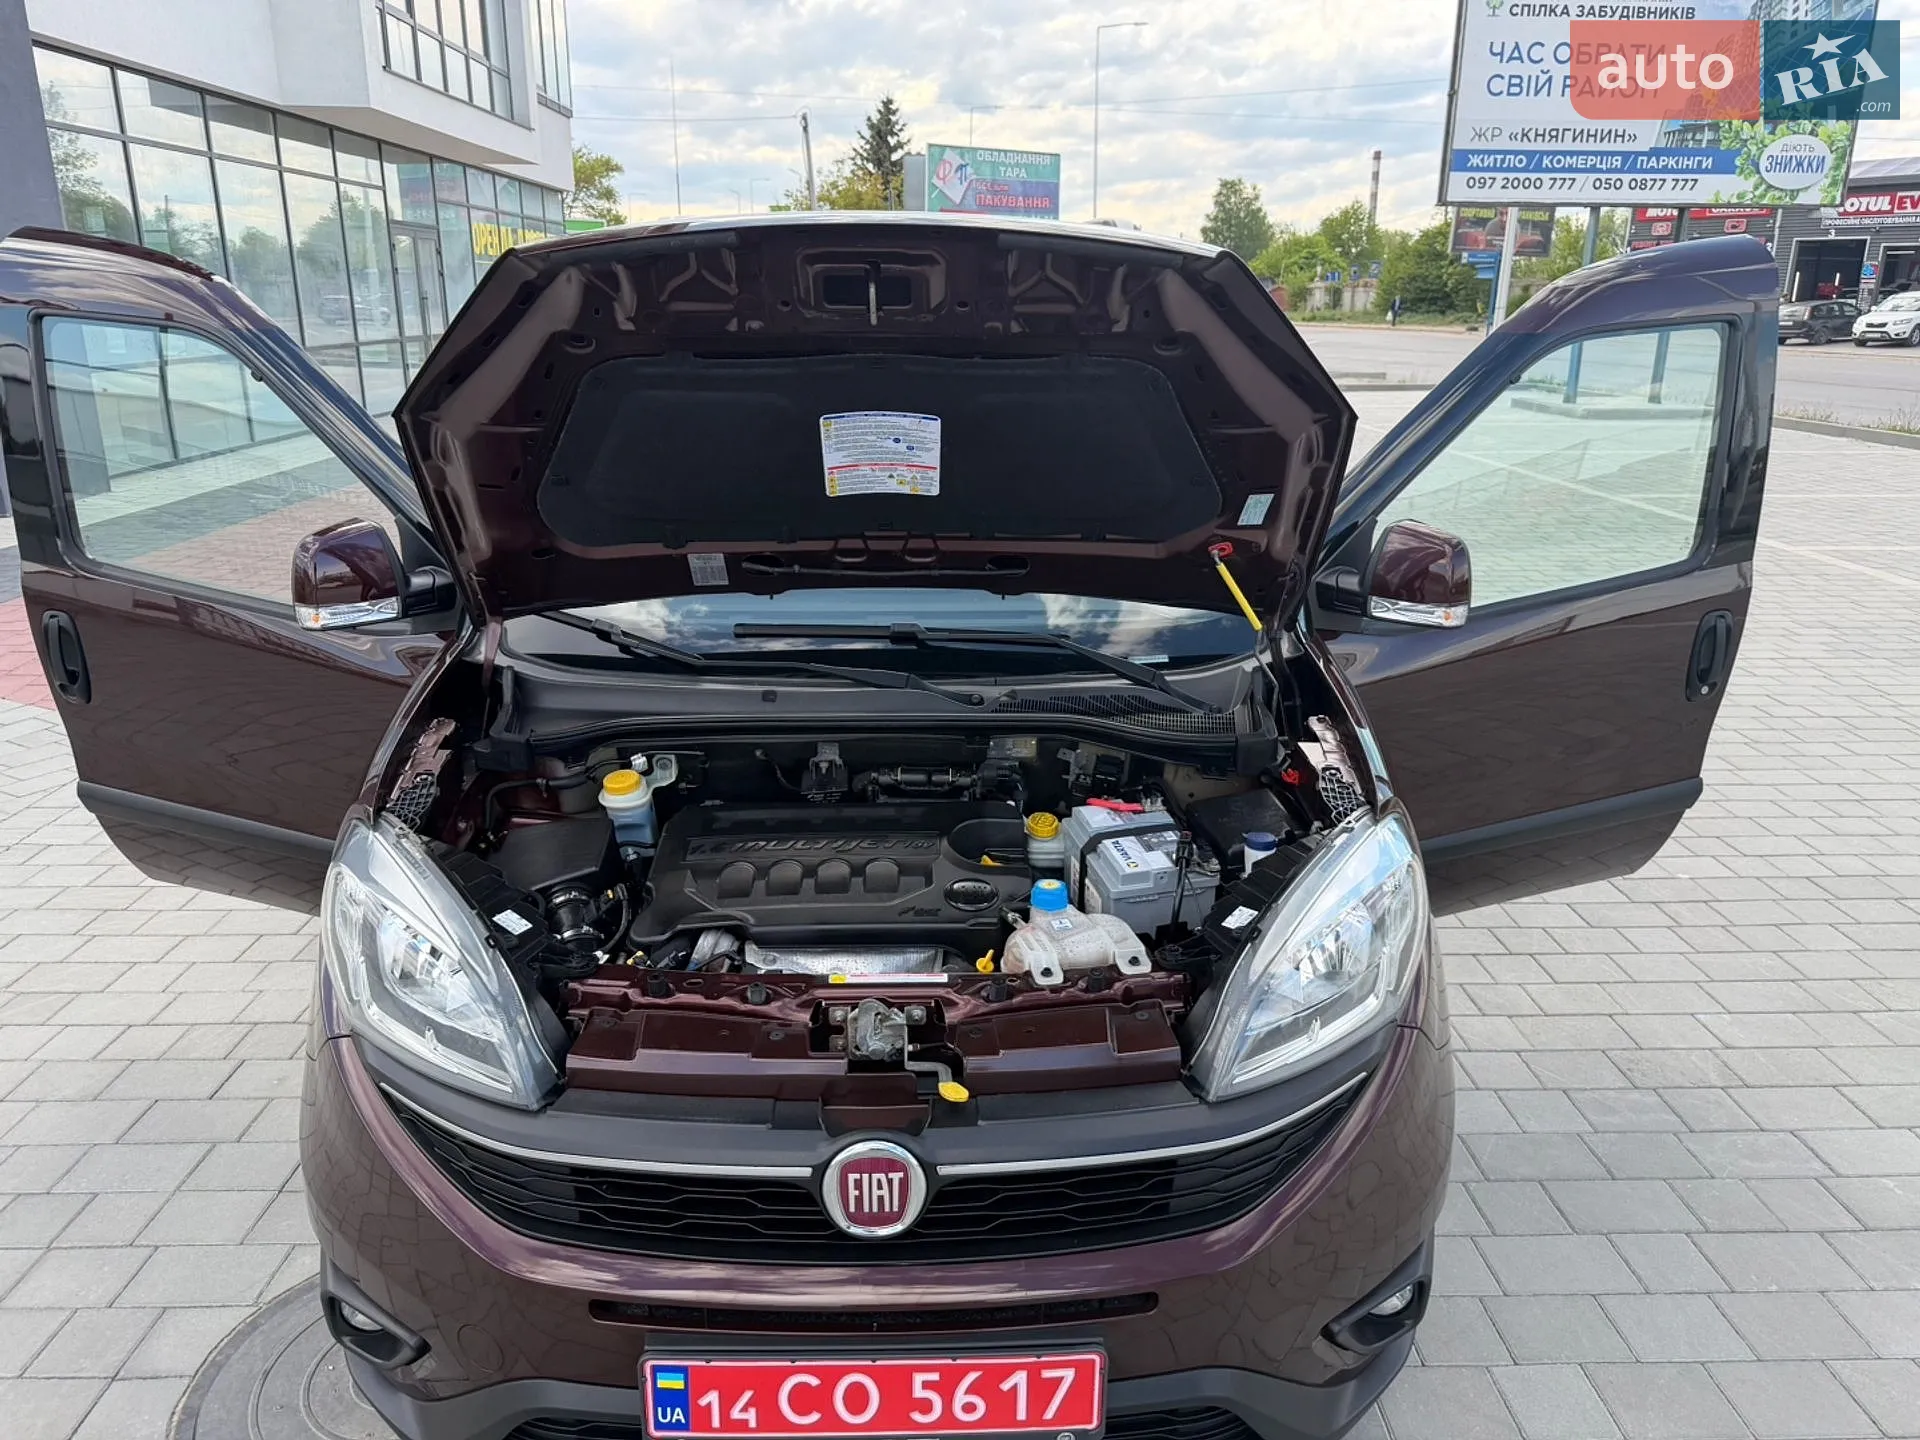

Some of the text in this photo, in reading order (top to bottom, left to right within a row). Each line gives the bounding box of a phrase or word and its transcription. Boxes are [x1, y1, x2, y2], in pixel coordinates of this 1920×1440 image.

[1509, 4, 1696, 20] СПІЛКА ЗАБУДІВНИКІВ
[1488, 41, 1666, 66] ЧАС ОБРАТИ
[1486, 69, 1660, 98] СВІЙ РАЙОН
[1469, 126, 1638, 144] ЖР «КНЯГИНИН»
[976, 150, 1051, 165] ОБЛАДНАННЯ
[1466, 154, 1527, 168] ЖИТЛО
[1542, 155, 1621, 171] КОМЕРЦІЯ
[1637, 156, 1713, 170] ПАРКІНГИ
[1765, 154, 1826, 173] ЗНИЖКИ
[999, 166, 1028, 178] ТАРА
[1466, 176, 1497, 190] 097
[1500, 176, 1544, 190] 2000
[1548, 177, 1577, 191] 777
[1592, 177, 1624, 191] 050
[1628, 177, 1666, 191] 0877
[1670, 178, 1699, 192] 777
[975, 194, 1051, 209] ПАКУВАННЯ
[1835, 195, 1893, 213] OTUL
[847, 1171, 904, 1213] FIAT
[657, 1367, 1077, 1429] UA 14 CO 5617
